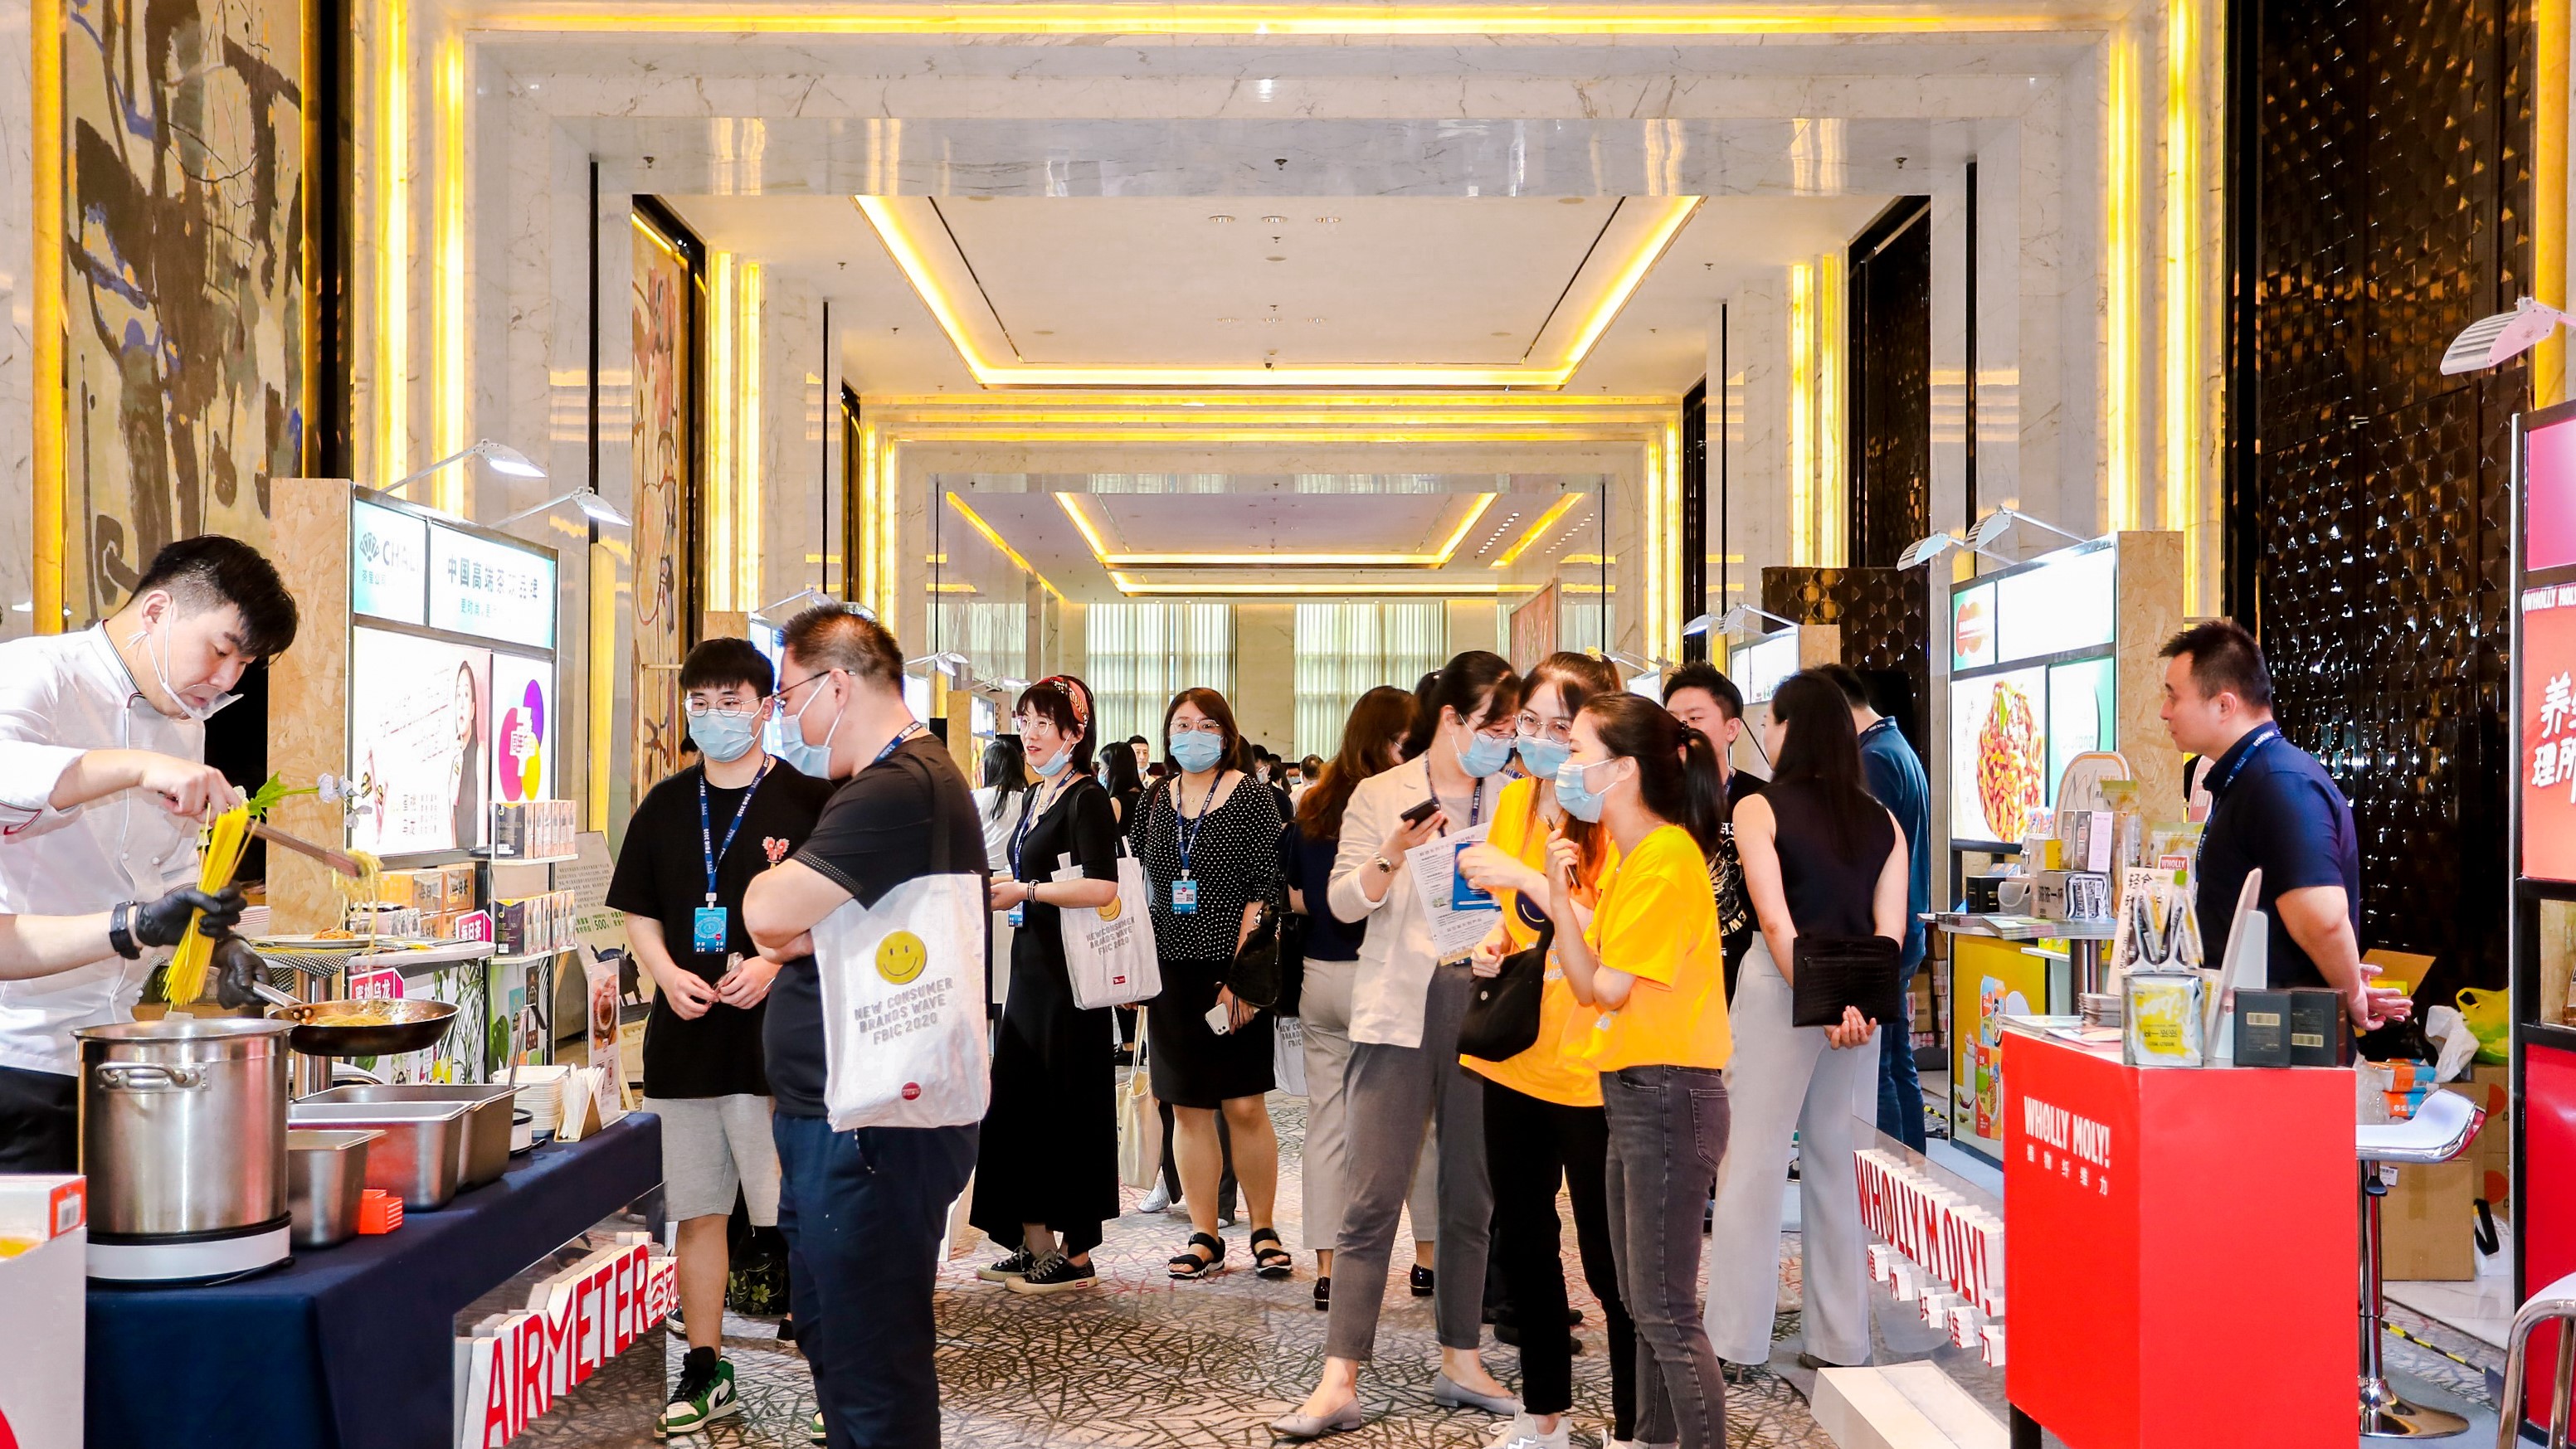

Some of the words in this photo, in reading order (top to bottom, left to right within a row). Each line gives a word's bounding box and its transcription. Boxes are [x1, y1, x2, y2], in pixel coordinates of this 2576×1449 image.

[2161, 859, 2185, 868] WHOLLY
[855, 1001, 882, 1021] NEW
[887, 977, 953, 1009] CONSUMER
[859, 1006, 908, 1033] BRANDS
[912, 994, 946, 1014] WAVE
[874, 1024, 903, 1045] FBIC
[905, 1012, 937, 1033] 2020
[2023, 1095, 2070, 1150] WHOLLY
[2072, 1114, 2111, 1169] MOLY!
[1853, 1150, 1921, 1267] WHOLLY
[1922, 1194, 1991, 1317] MOLY!
[483, 1244, 650, 1449] AIRMETER
